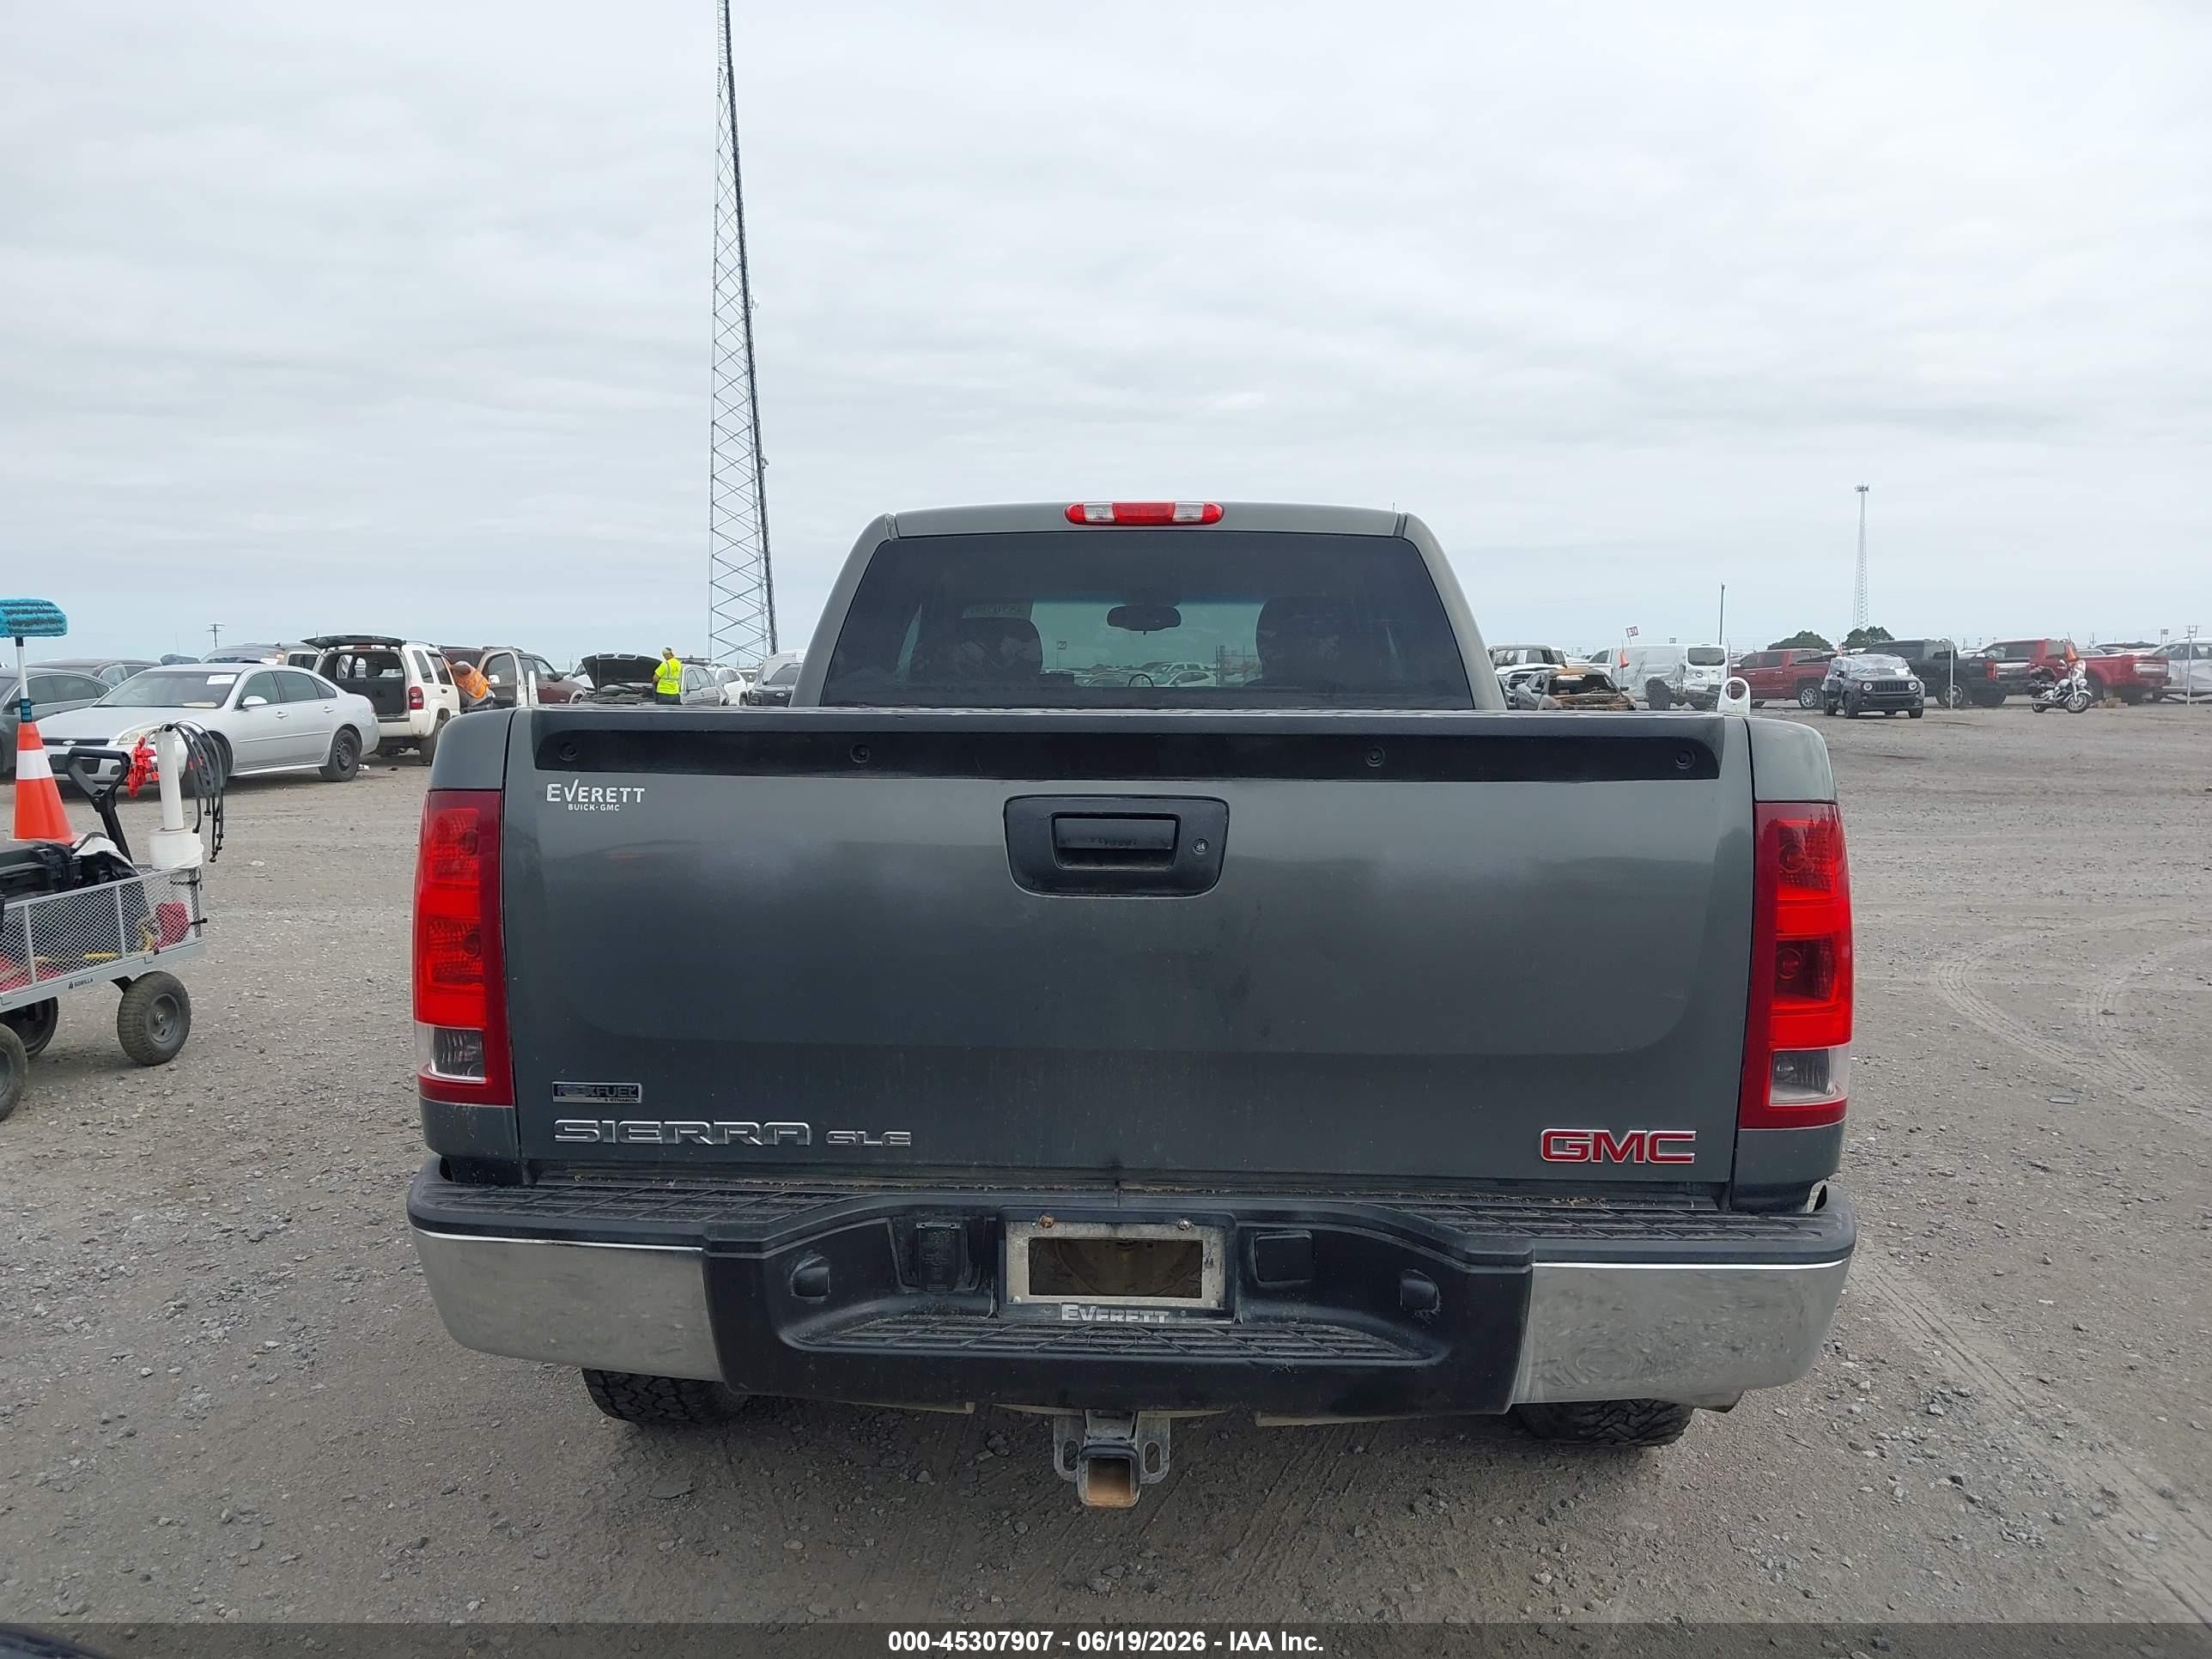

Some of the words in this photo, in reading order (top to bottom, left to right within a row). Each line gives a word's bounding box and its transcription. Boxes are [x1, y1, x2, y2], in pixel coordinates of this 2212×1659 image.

[546, 779, 646, 803] EVERETT
[554, 1119, 811, 1146] SIERRA
[825, 1130, 912, 1147] SLE
[1540, 1127, 1697, 1164] GMC
[1061, 1303, 1170, 1324] EVERETT
